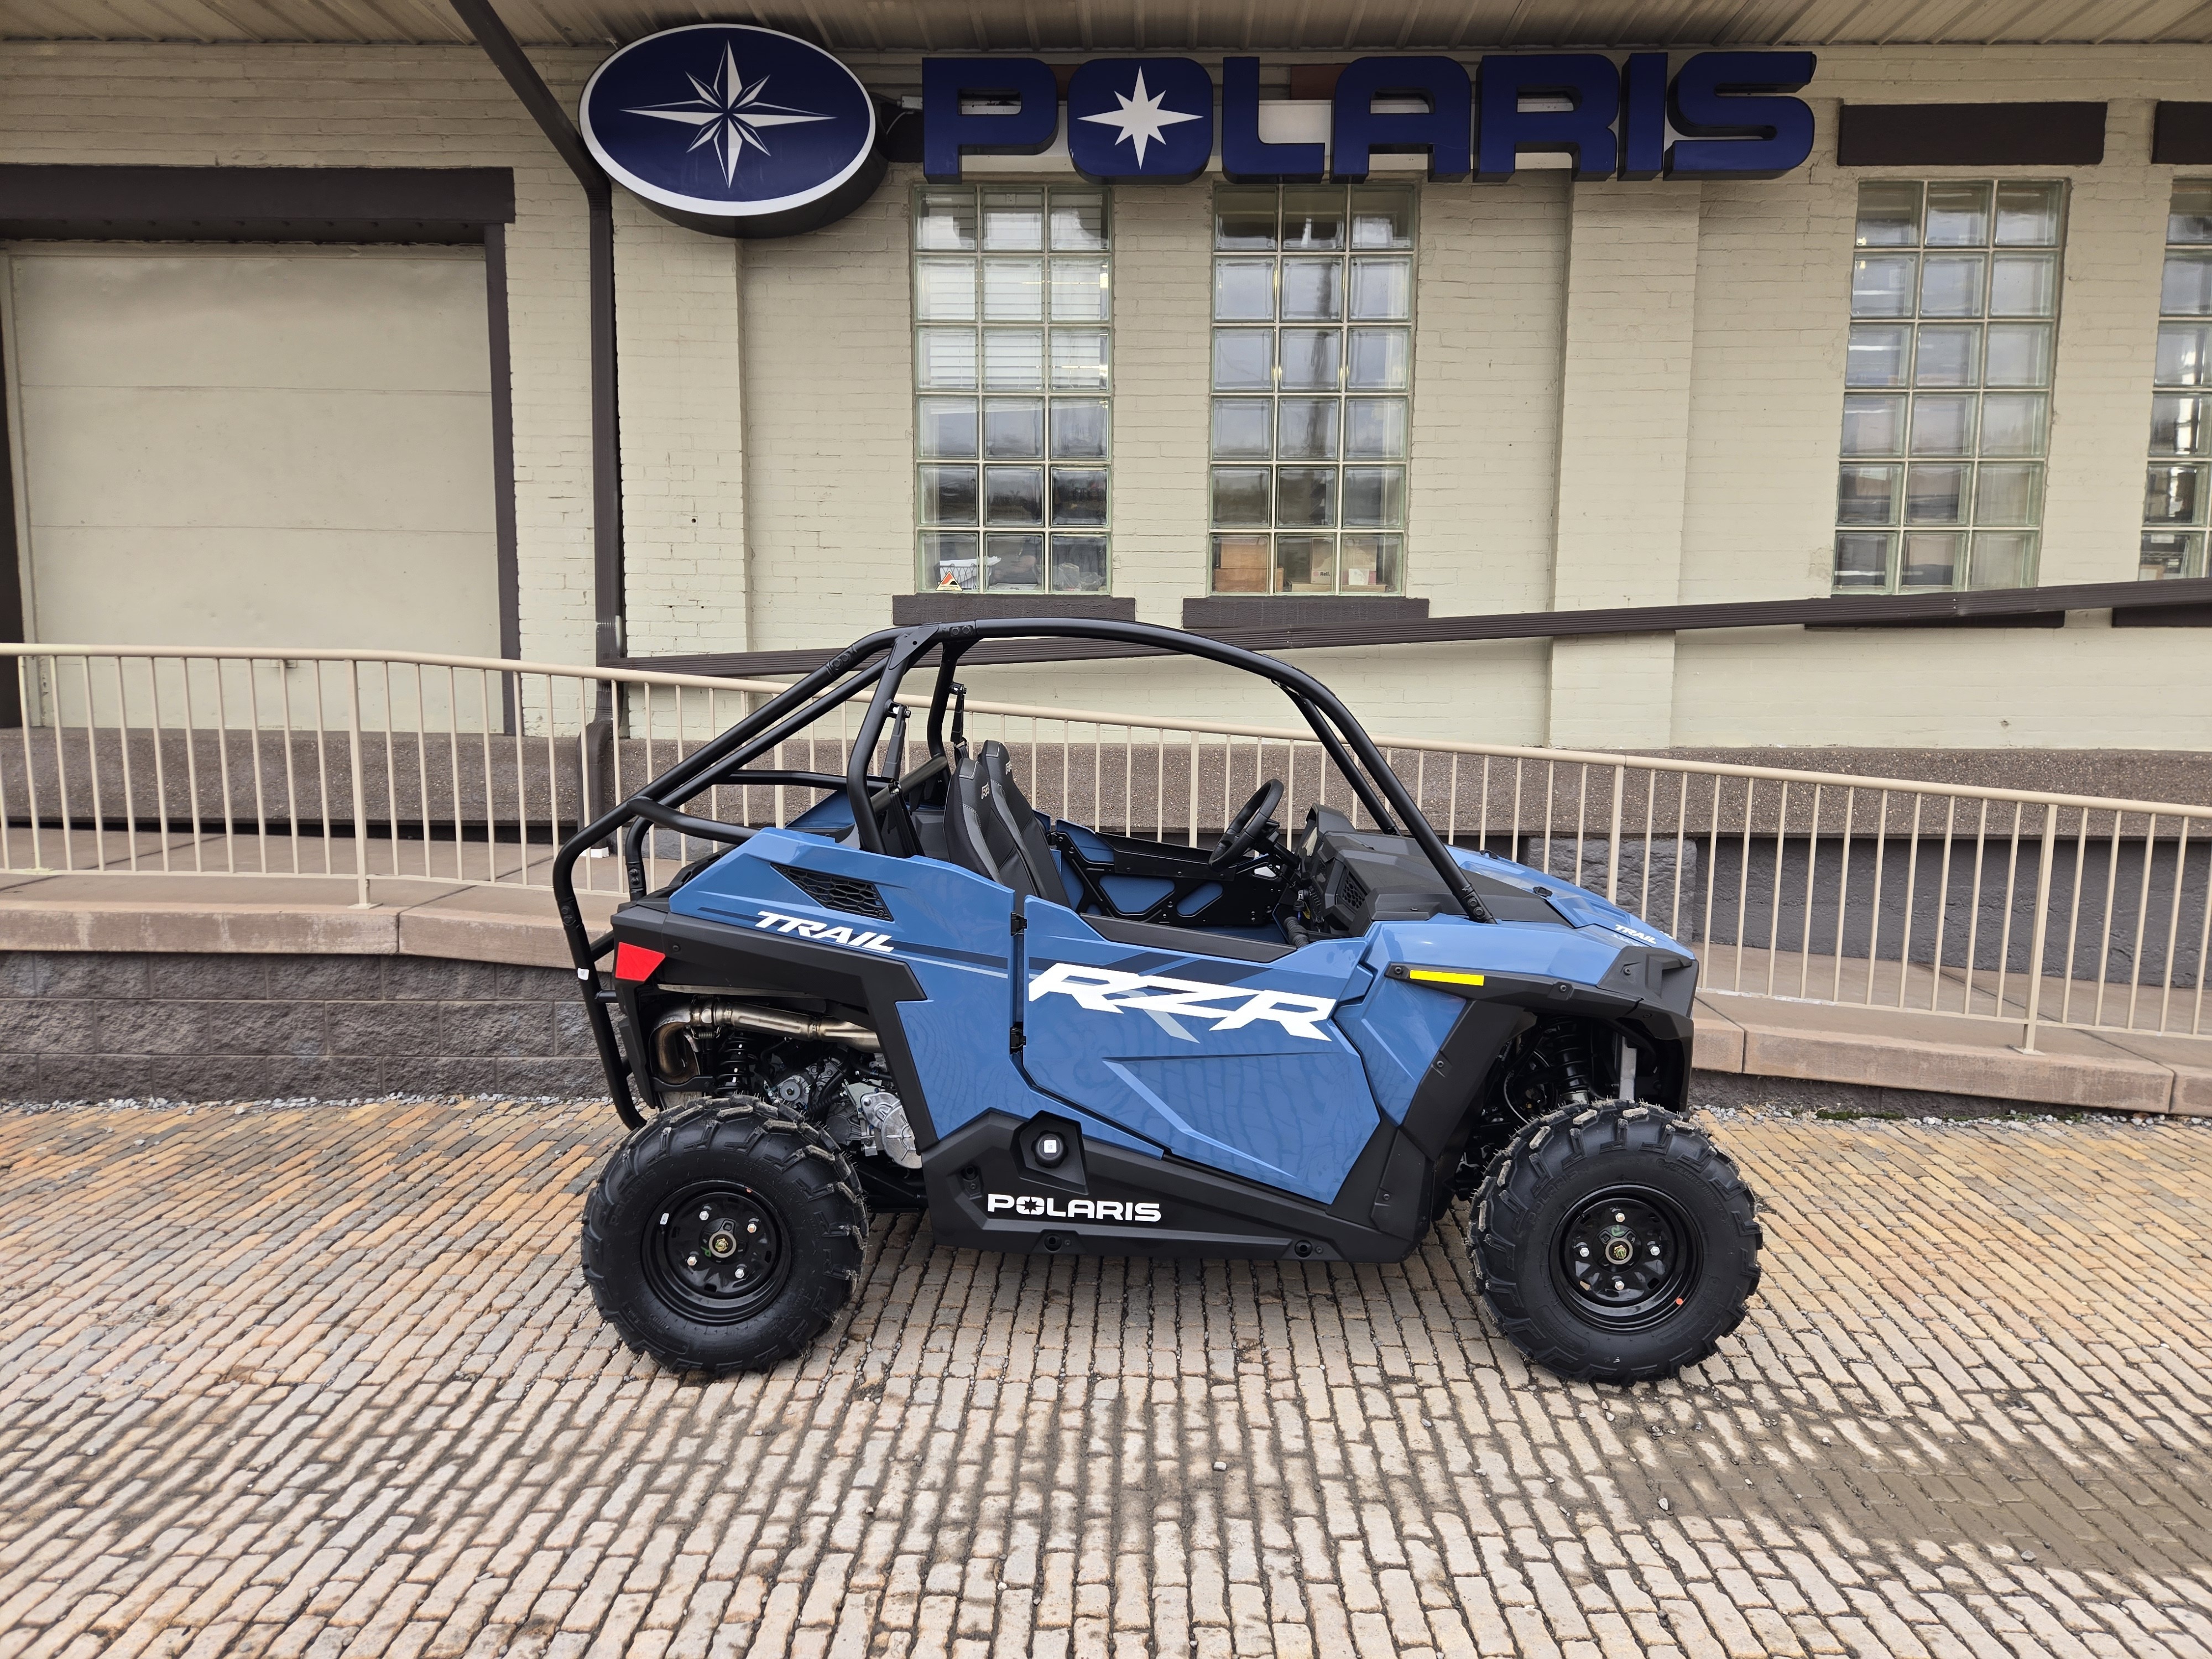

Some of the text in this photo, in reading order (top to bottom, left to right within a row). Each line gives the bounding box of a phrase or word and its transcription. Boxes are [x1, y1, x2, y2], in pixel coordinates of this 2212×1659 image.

[922, 51, 1815, 184] POLARIS
[755, 911, 894, 953] TRAIL
[1615, 924, 1656, 945] TRAIL
[1029, 962, 1337, 1042] RZR
[987, 1193, 1161, 1222] POLARIS
